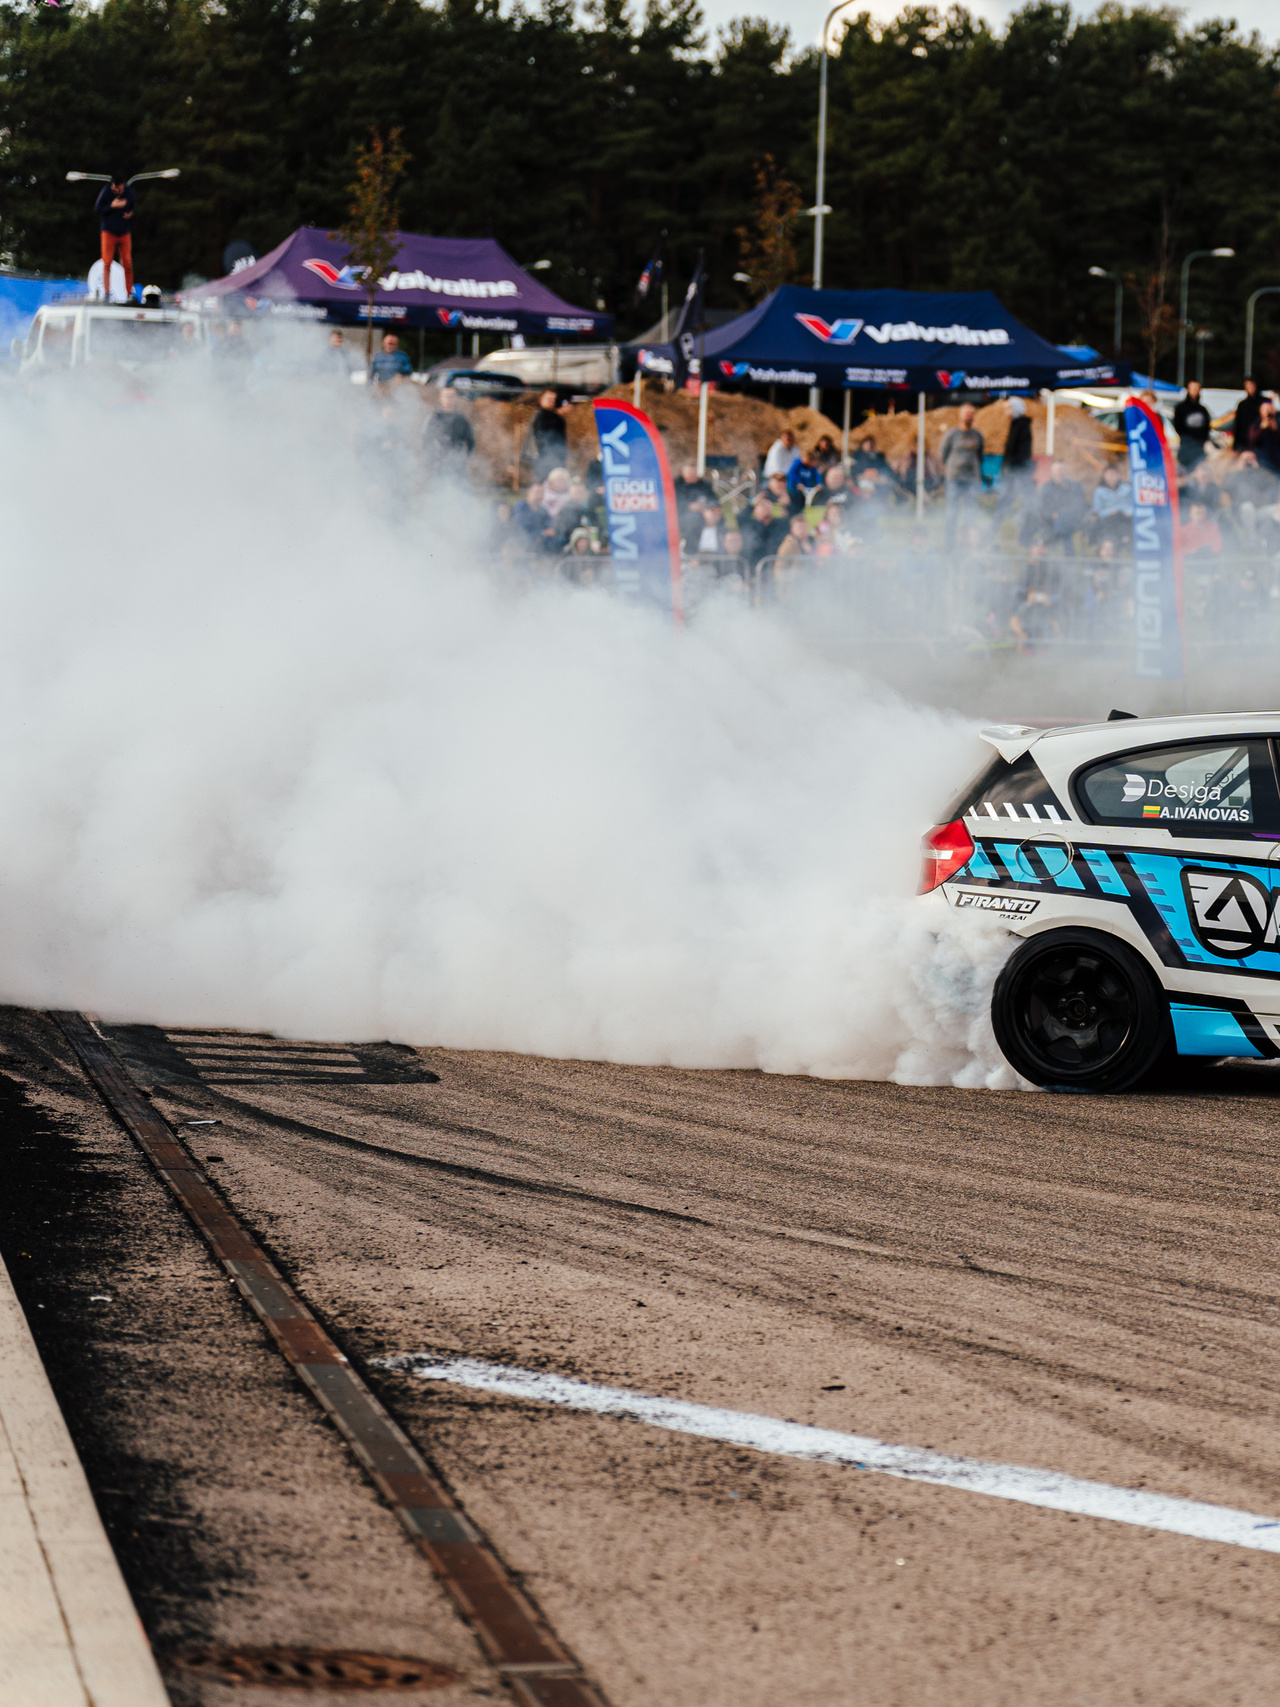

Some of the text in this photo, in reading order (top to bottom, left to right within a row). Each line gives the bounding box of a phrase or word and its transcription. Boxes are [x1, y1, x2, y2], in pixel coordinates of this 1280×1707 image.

[377, 269, 517, 298] Valvoline
[863, 320, 1010, 346] Valvoline
[1146, 779, 1222, 803] Desiga
[1159, 805, 1250, 822] A.IVANOVAS
[958, 893, 1037, 912] FIRANTO
